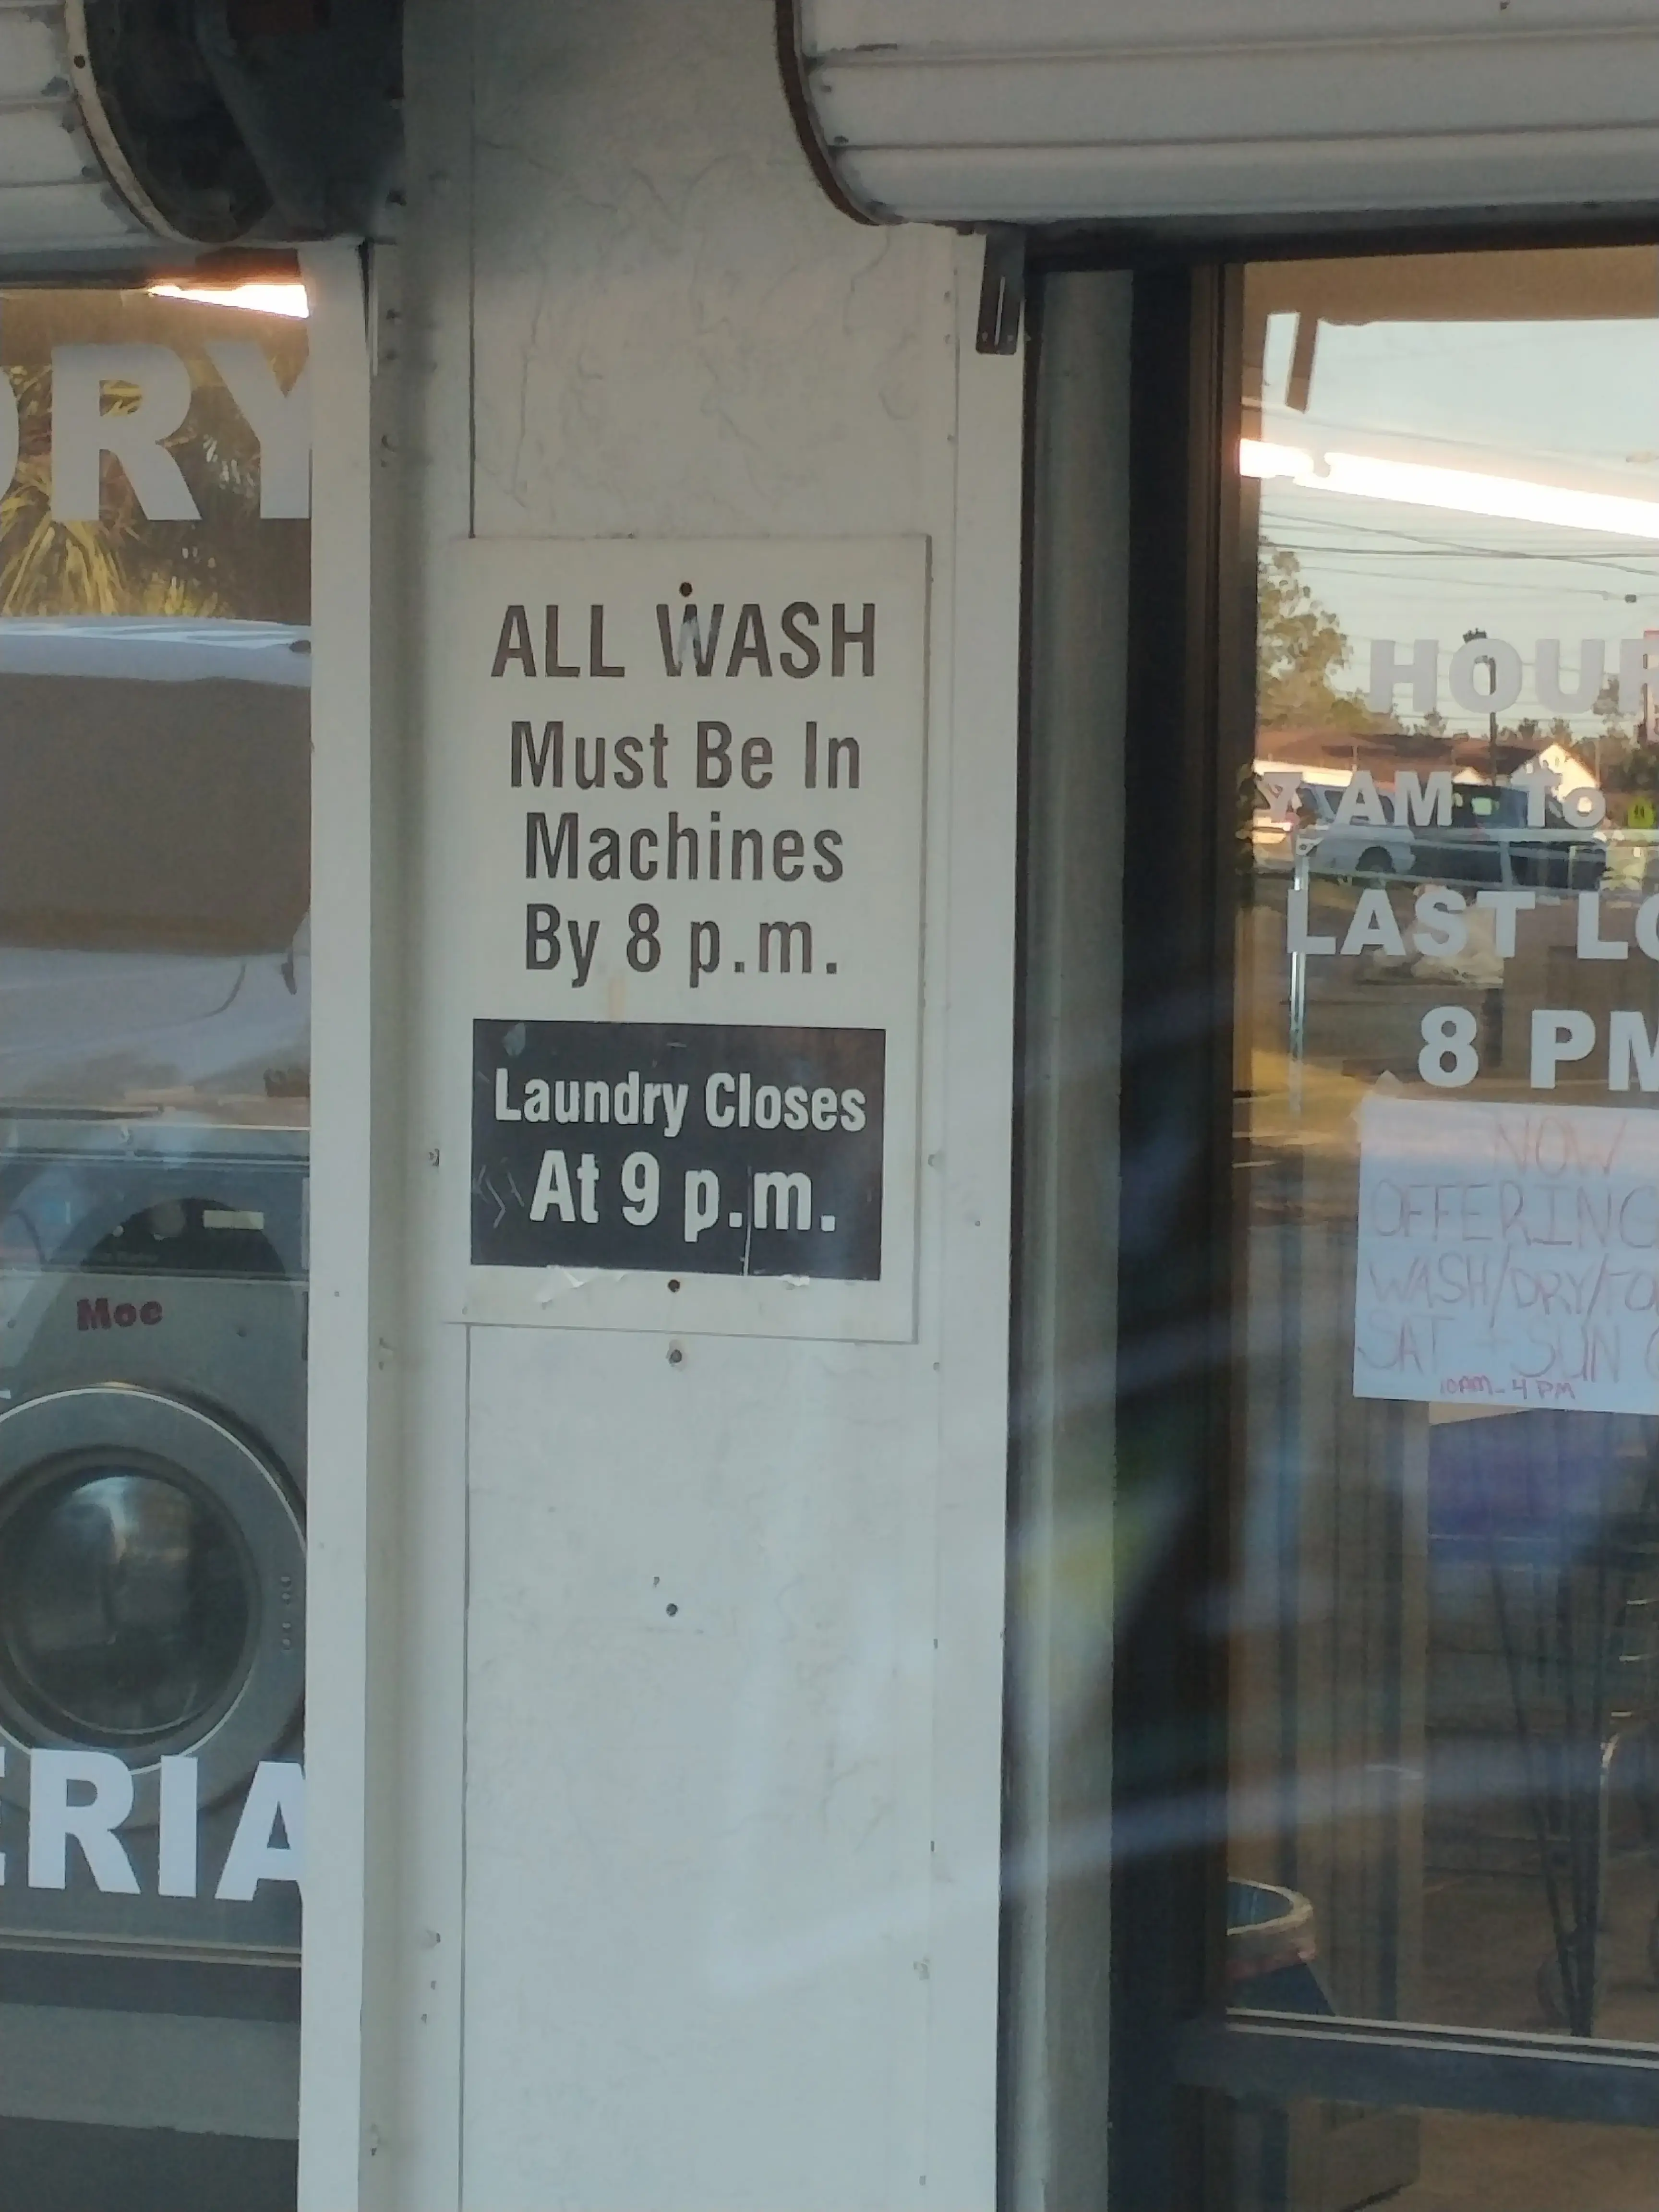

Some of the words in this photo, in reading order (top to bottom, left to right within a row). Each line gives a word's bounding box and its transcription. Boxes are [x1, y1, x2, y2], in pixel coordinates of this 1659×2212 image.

[0, 343, 310, 520] RY
[491, 604, 625, 678] ALL
[656, 601, 875, 679] WASH
[510, 721, 669, 790] Must
[696, 721, 773, 789] Be
[805, 721, 860, 789] In
[1333, 770, 1453, 826] AM
[1511, 772, 1606, 829] To
[525, 811, 843, 882] Machines
[526, 903, 600, 988] By
[626, 902, 661, 973] 8
[689, 919, 837, 988] p.m.
[1286, 889, 1535, 957] LAST
[1418, 1005, 1479, 1088] 8
[494, 1068, 688, 1138] Laundry
[705, 1072, 866, 1132] Closes
[1493, 1115, 1628, 1178] NOW
[529, 1150, 599, 1224] At
[622, 1151, 660, 1226] 9
[684, 1169, 836, 1243] p.m.
[1356, 1310, 1455, 1375] SAT
[1509, 1316, 1621, 1383] SUN
[0, 1746, 305, 1901] RIA
